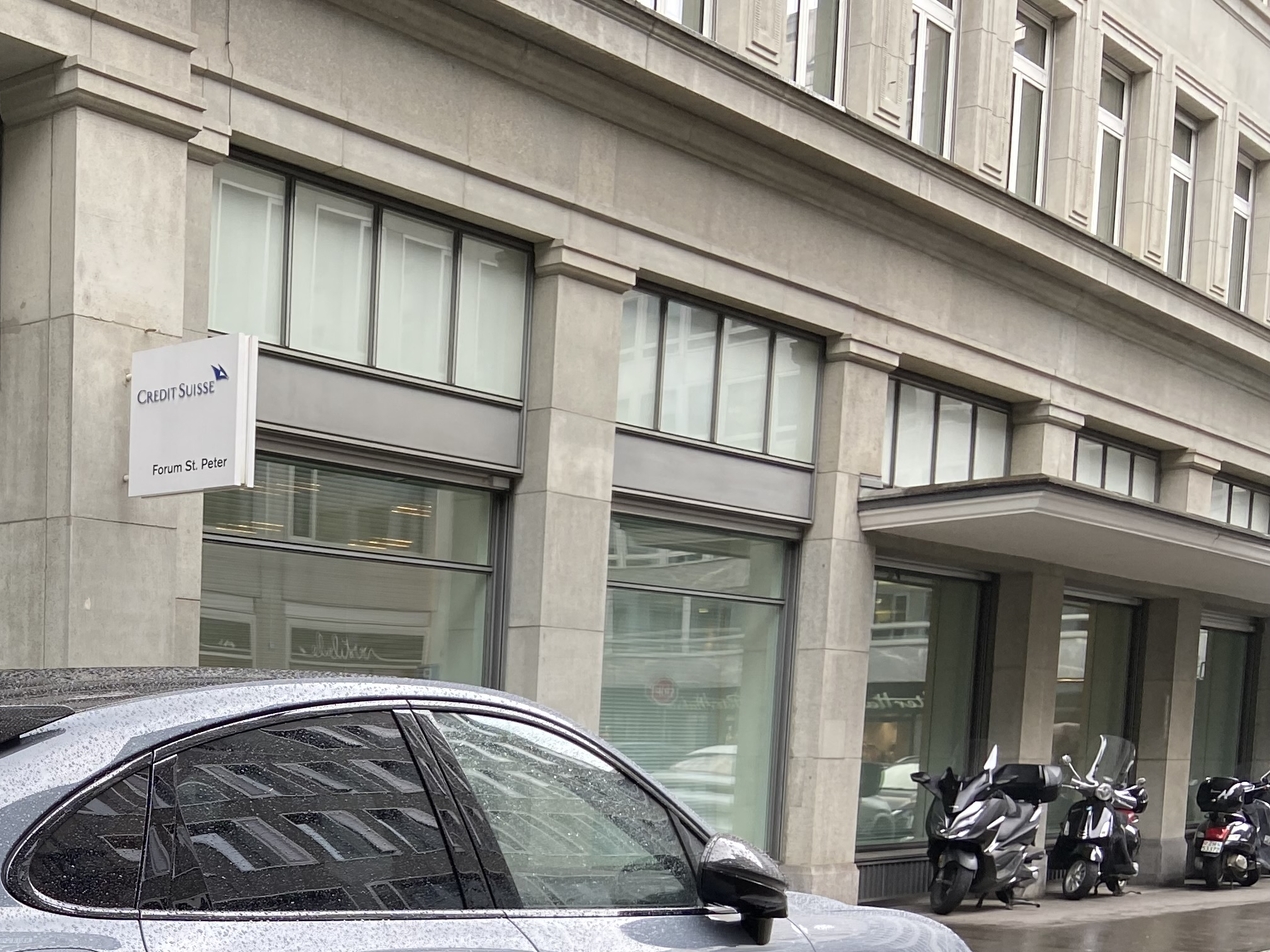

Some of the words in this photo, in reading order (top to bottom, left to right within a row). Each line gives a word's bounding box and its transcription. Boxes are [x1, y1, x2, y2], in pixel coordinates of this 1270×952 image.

[137, 387, 177, 405] CREDIT
[178, 380, 215, 399] SUISSE
[152, 464, 182, 476] Forum
[185, 460, 198, 472] St.
[201, 456, 228, 470] Peter
